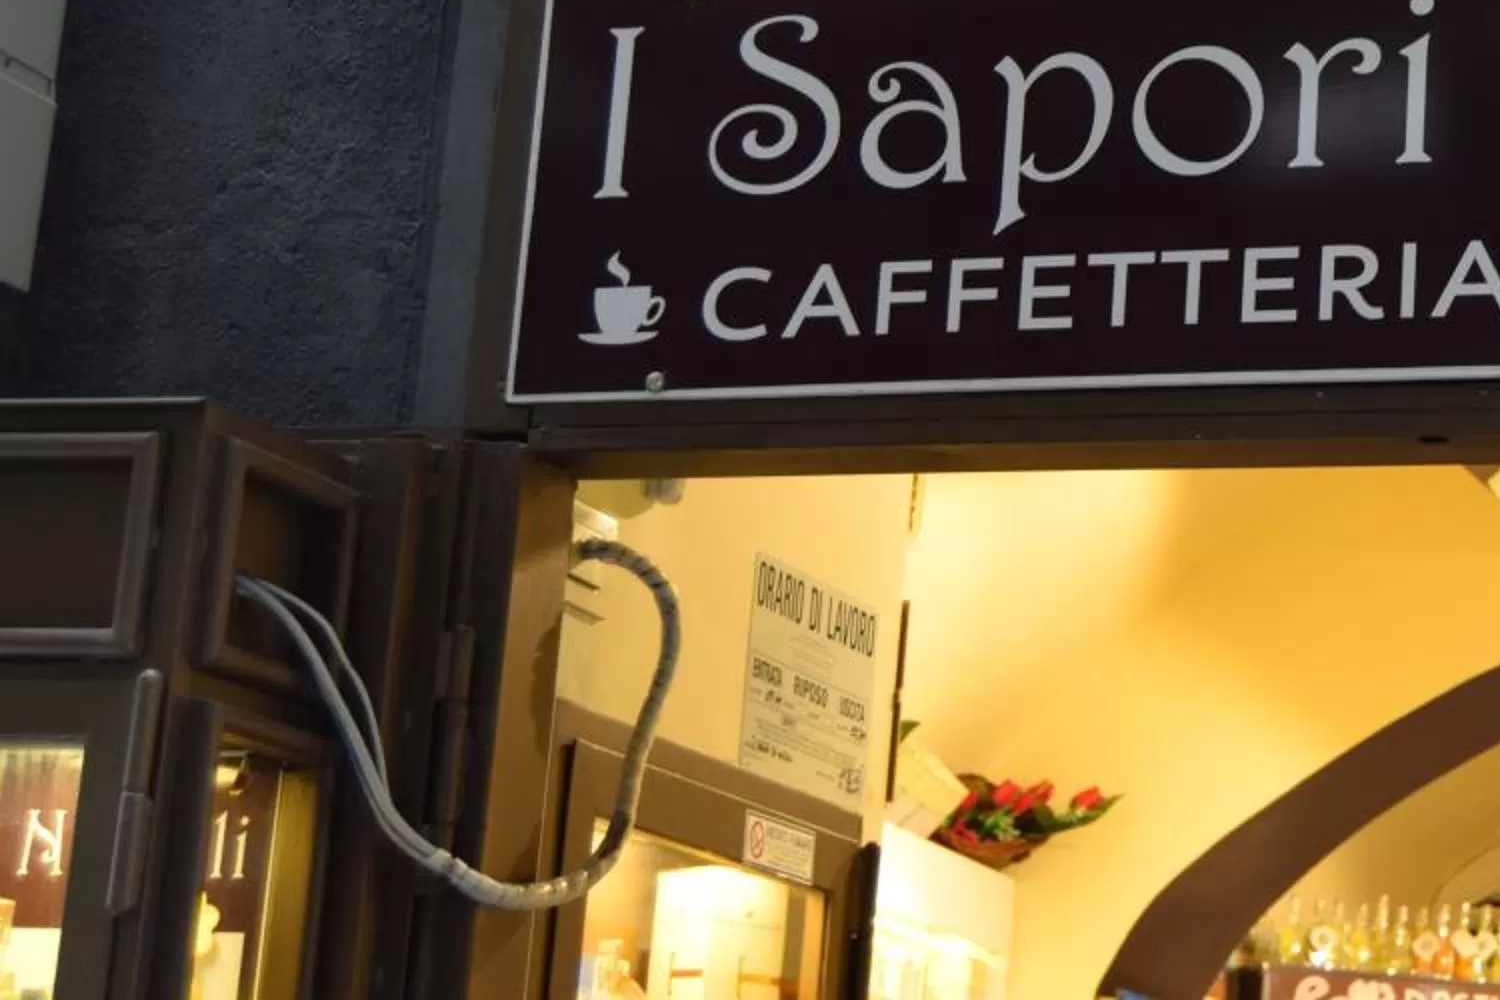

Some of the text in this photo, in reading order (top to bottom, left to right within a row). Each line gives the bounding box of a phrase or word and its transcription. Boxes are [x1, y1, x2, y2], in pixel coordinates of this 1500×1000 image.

[593, 26, 645, 199] I
[756, 561, 804, 625] ORARIO
[808, 587, 822, 633] DI
[826, 596, 876, 657] LAVORO
